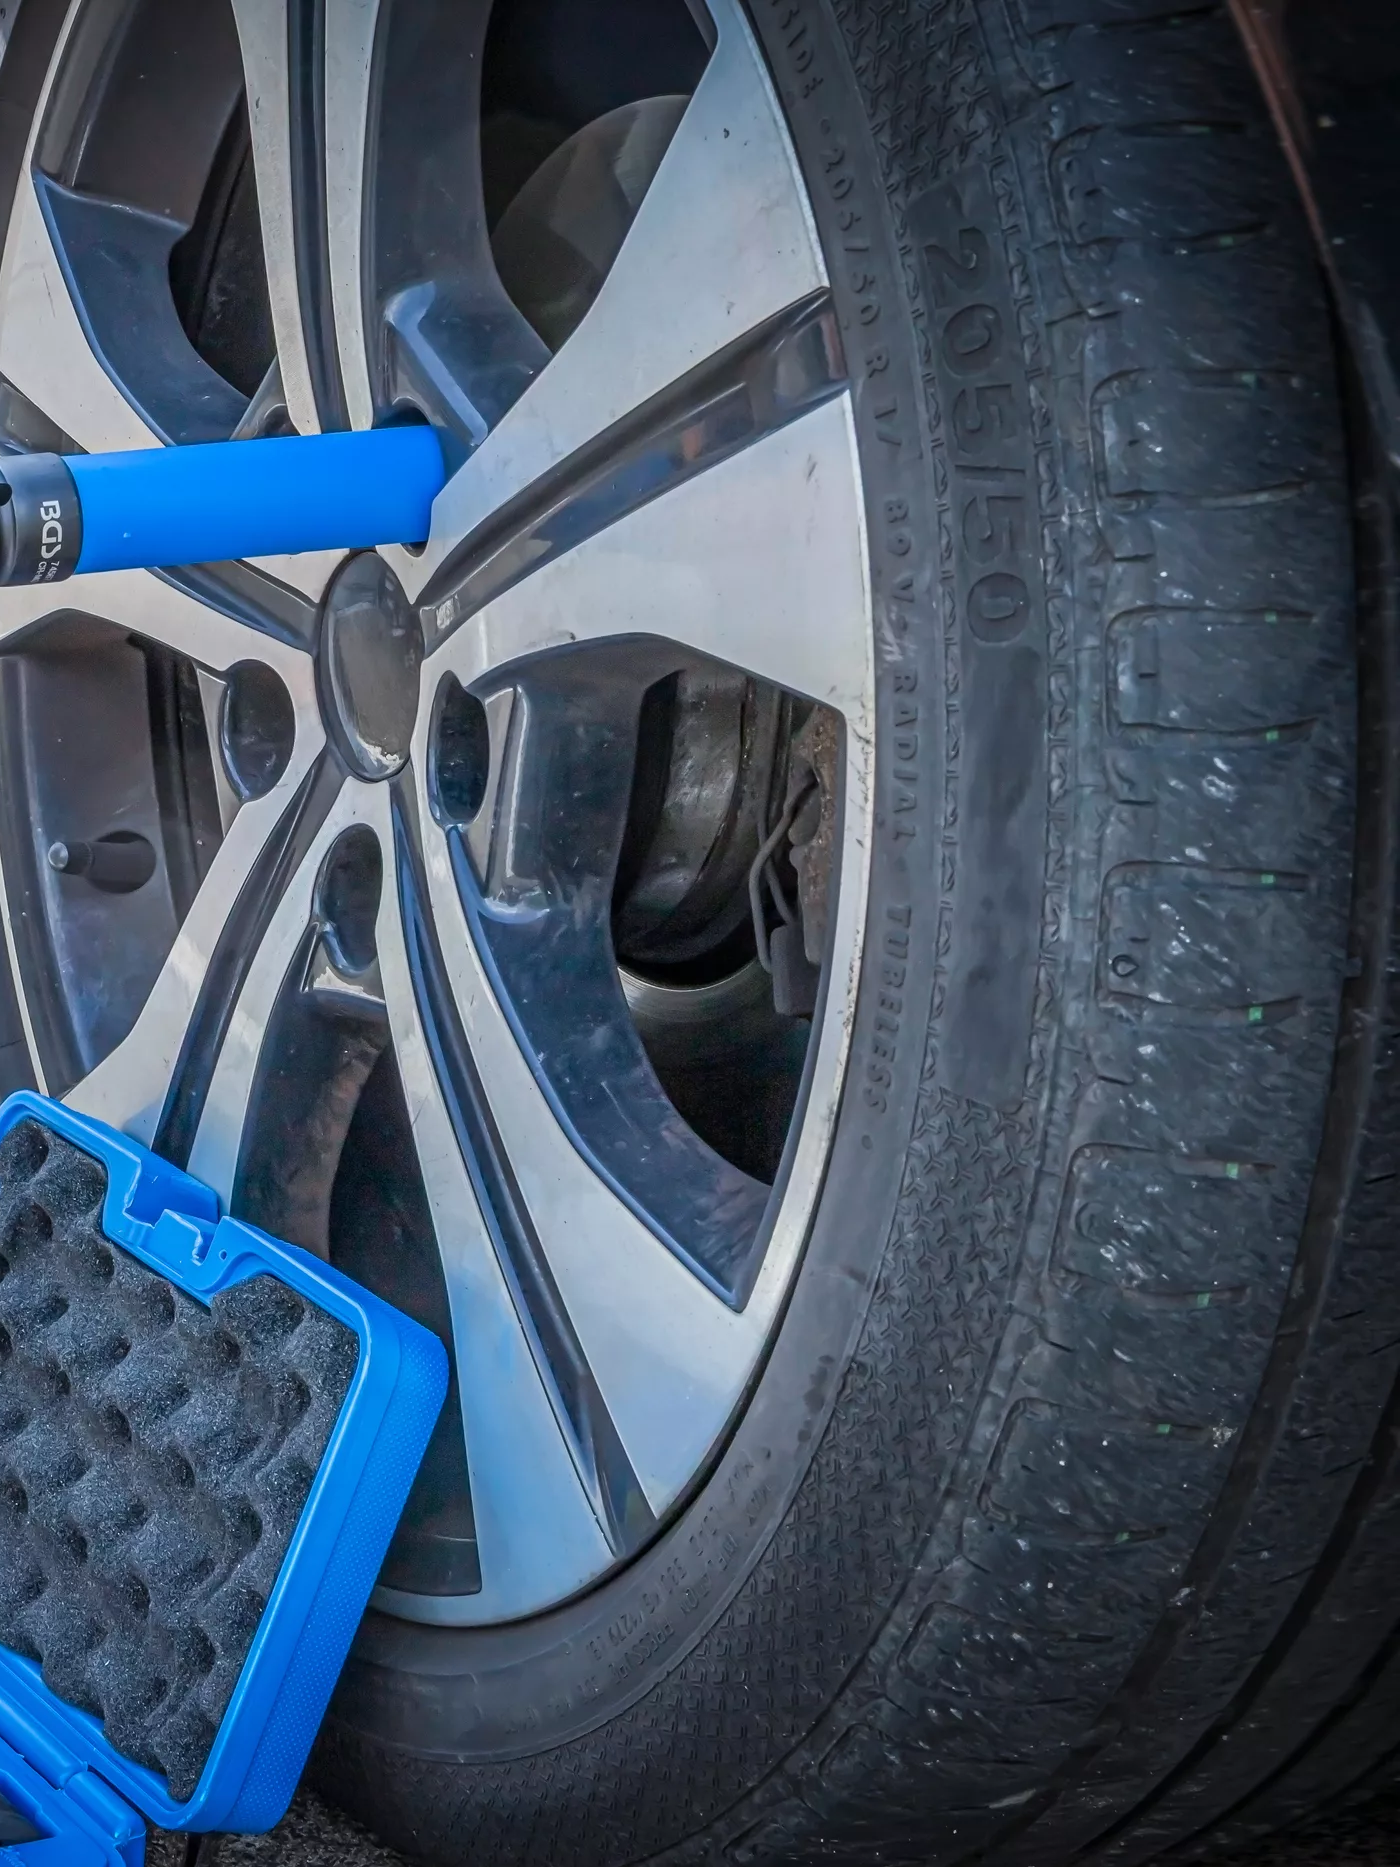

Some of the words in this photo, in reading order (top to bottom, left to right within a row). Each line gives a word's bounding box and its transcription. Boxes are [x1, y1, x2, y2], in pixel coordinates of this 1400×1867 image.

[40, 500, 63, 559] BGS
[924, 226, 1030, 643] 205/50
[893, 667, 918, 841] RADIAL
[862, 903, 912, 1114] TUBELESS
